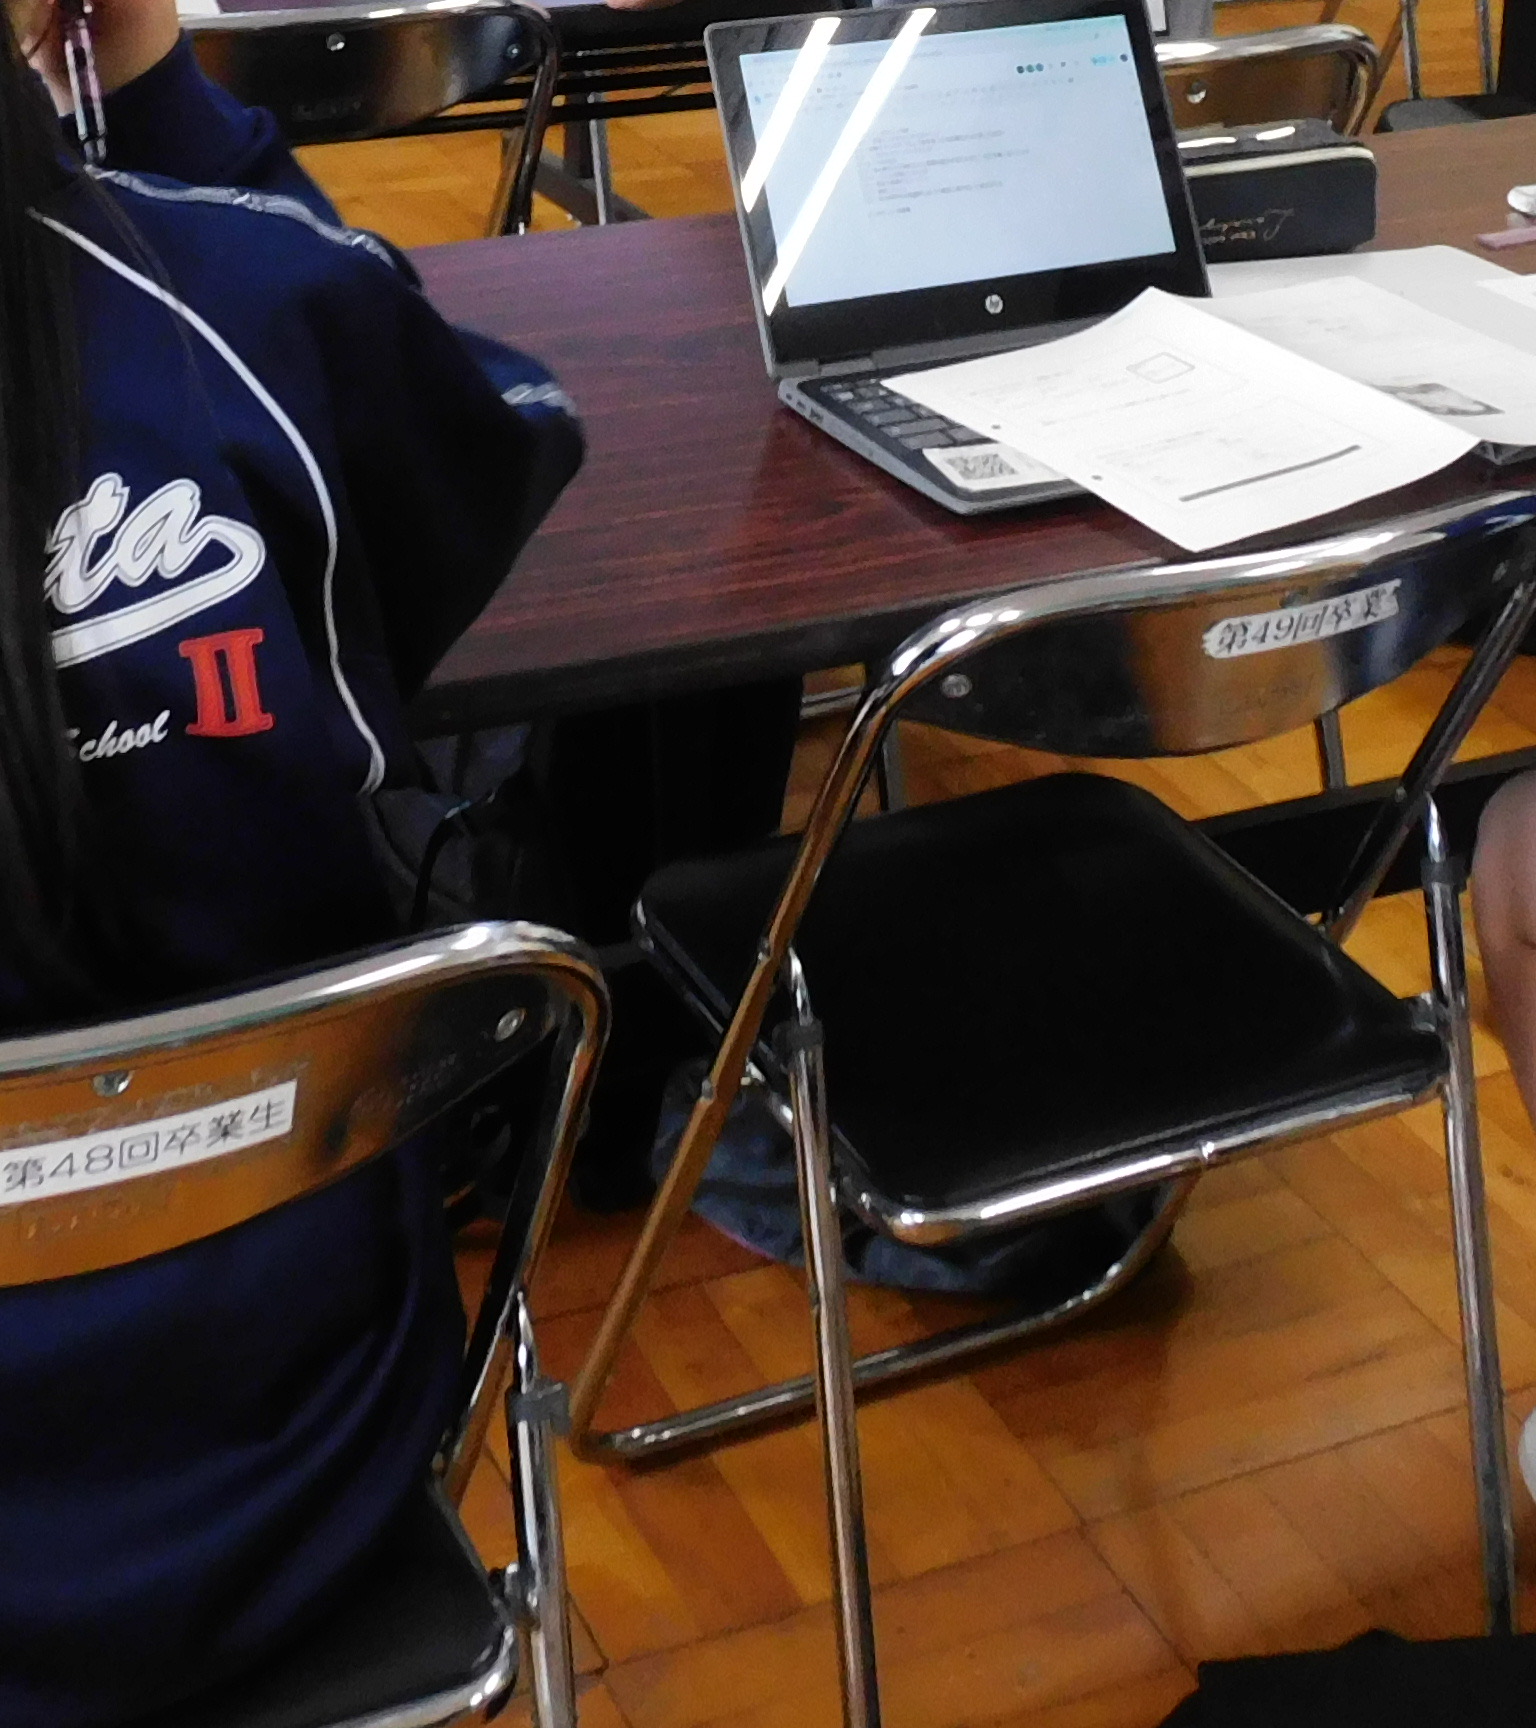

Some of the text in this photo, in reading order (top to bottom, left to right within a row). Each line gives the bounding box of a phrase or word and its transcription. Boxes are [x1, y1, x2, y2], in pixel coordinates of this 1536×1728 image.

[2, 1097, 289, 1194] 第48回卒業生
